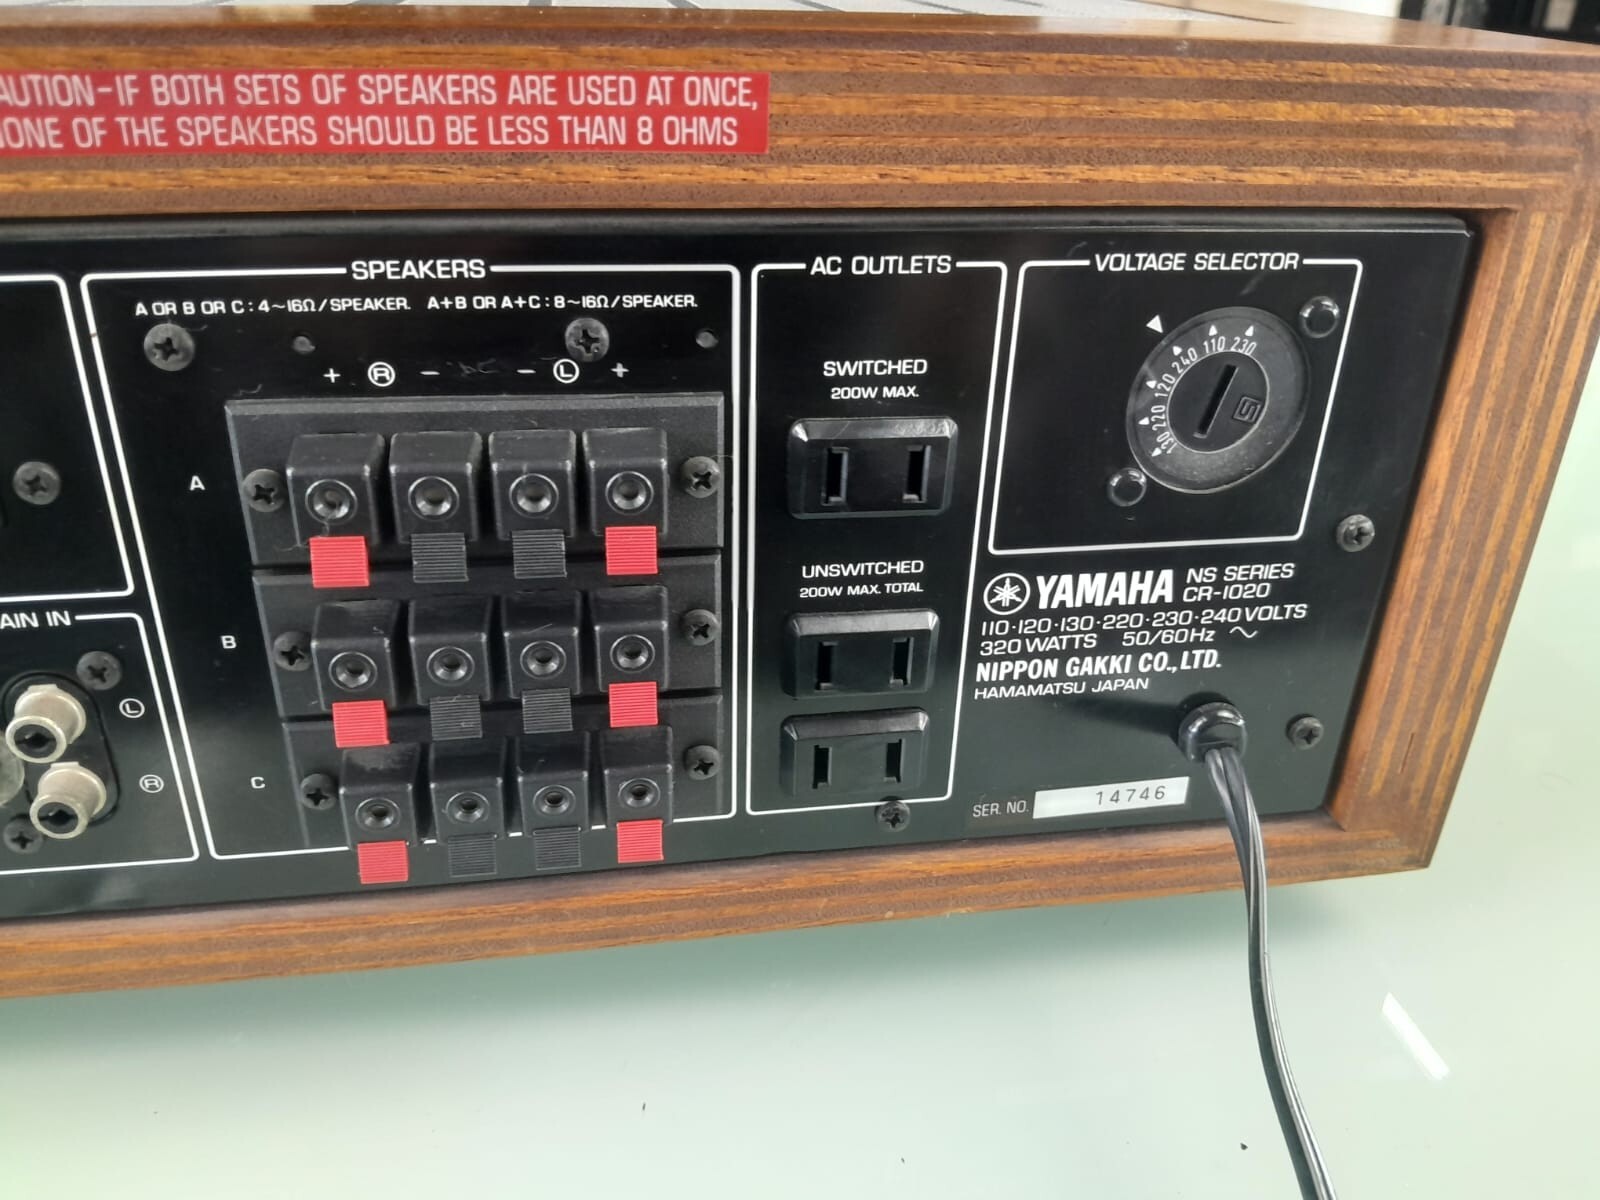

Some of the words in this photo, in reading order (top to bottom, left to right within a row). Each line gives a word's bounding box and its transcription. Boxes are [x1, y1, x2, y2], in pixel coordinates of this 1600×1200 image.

[151, 74, 224, 106] BOTH
[234, 74, 300, 105] SETS
[311, 74, 347, 105] OF
[359, 74, 497, 105] SPEAKERS
[508, 75, 557, 105] ARE
[568, 76, 636, 106] USED
[646, 76, 675, 107] AT
[684, 76, 758, 110] ONCE,
[0, 117, 64, 148] ONE
[72, 117, 107, 148] OF
[115, 117, 168, 146] THE
[176, 116, 317, 146] SPEAKERS
[328, 115, 435, 145] SHOULD
[446, 115, 479, 145] BE
[488, 115, 549, 145] LESS
[558, 116, 626, 145] THAN
[637, 116, 653, 145] 8
[662, 117, 738, 146] OHMS
[351, 259, 486, 280] SPEAKERS
[810, 256, 842, 276] AC
[851, 255, 952, 275] OUTLETS
[1095, 253, 1187, 272] VOLTAGE
[1193, 252, 1300, 271] SELECTOR
[135, 303, 148, 316] A
[152, 302, 177, 316] OR
[183, 302, 195, 315] B
[201, 301, 225, 315] OR
[427, 296, 467, 310] A+B
[473, 296, 497, 310] OR
[1203, 336, 1226, 354] 110
[1230, 336, 1257, 356] 230
[823, 359, 928, 377] SWITCHED
[1171, 347, 1199, 374] 240
[831, 387, 878, 400] 200W
[882, 385, 919, 399] MAX.
[1154, 373, 1176, 398] 120
[1150, 404, 1167, 431] 220
[1156, 431, 1178, 455] 130
[189, 475, 206, 491] A
[802, 560, 924, 578] UNSWITCHED
[1186, 567, 1218, 583] NS
[1223, 562, 1296, 582] SERIES
[799, 586, 843, 598] 200W
[847, 584, 881, 595] MAX.
[884, 582, 924, 594] TOTAL
[1036, 569, 1174, 609] YAMAHA
[1182, 582, 1271, 603] CR-1020
[45, 610, 71, 627] IN
[1244, 603, 1308, 622] VOLTS
[220, 635, 237, 650] B
[979, 638, 1022, 657] 320
[1025, 633, 1098, 653] WATTS
[975, 658, 1058, 682] NIPPON
[1065, 654, 1132, 676] GAKKI
[973, 682, 1086, 700] HAMAMATSU
[1091, 677, 1149, 693] JAPAN
[250, 776, 266, 790] C
[1096, 785, 1167, 806] 14746
[972, 803, 1001, 818] SER.
[1006, 800, 1029, 815] NO.
